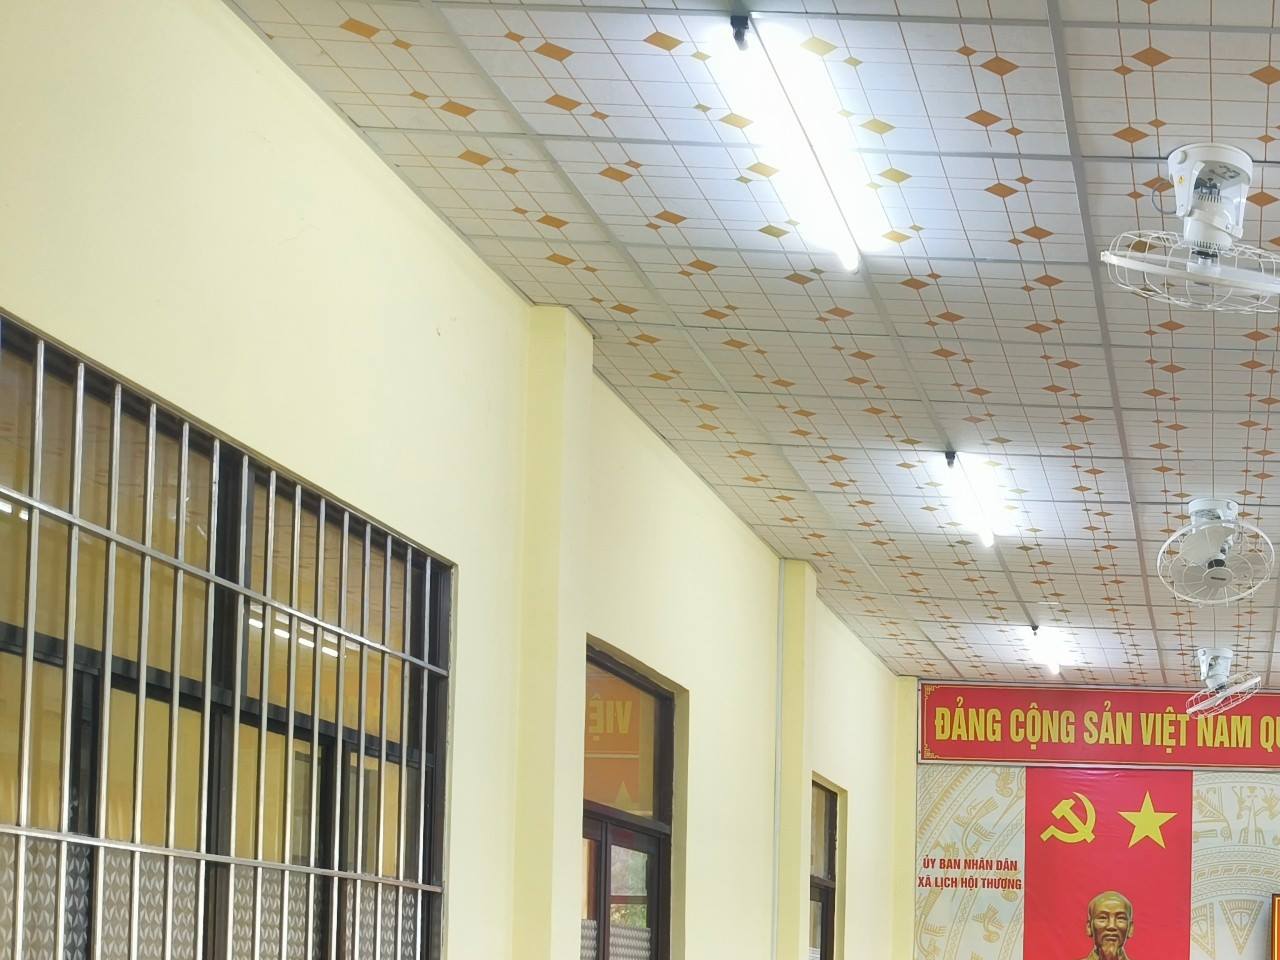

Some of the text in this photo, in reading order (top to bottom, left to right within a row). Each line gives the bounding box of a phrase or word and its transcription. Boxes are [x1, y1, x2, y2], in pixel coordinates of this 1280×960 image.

[935, 697, 1001, 741] ĐẢNG
[1010, 702, 1075, 750] CỘNG
[1084, 701, 1132, 744] SẢN
[1140, 706, 1189, 753] VIỆT
[1197, 715, 1252, 748] NAM
[923, 855, 1018, 871] ỦY BAN NHÂN DÂN
[918, 875, 1022, 892] XÃ LỊCH HỘI THƯỢNG
